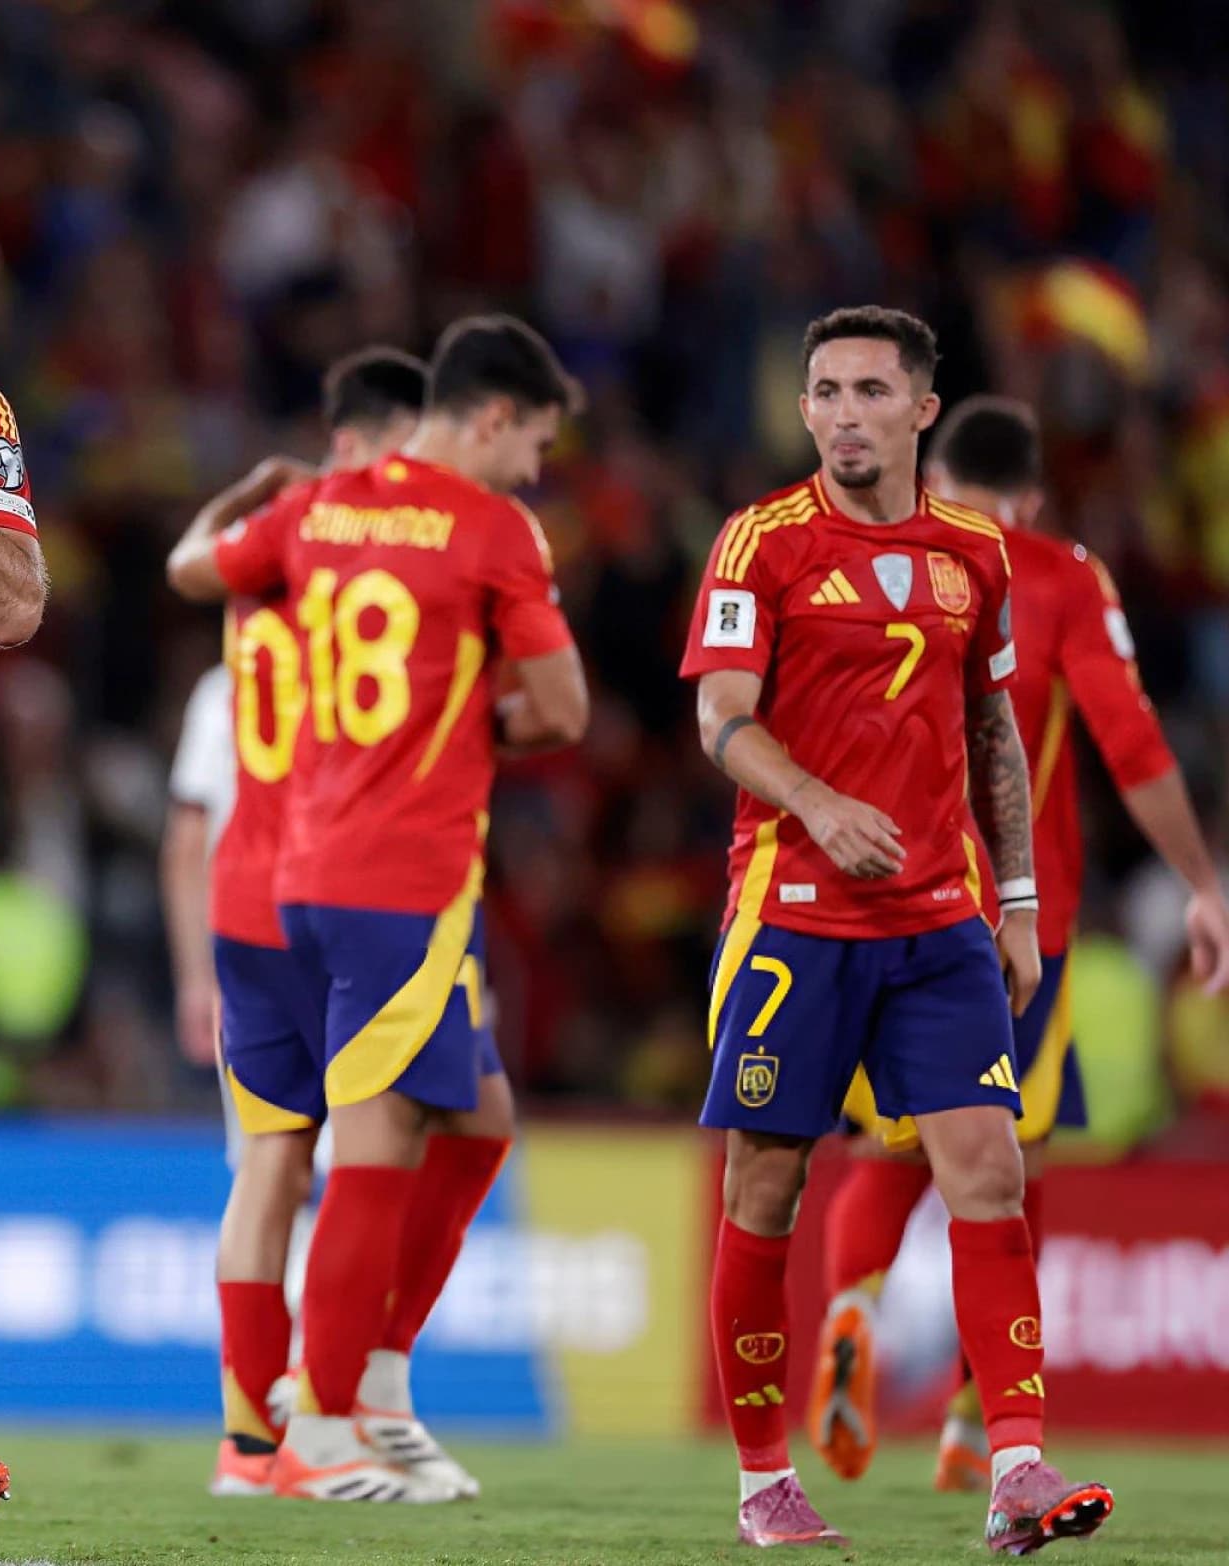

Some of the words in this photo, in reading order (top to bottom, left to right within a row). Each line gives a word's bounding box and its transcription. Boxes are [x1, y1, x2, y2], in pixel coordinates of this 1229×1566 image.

[296, 567, 420, 747] 18
[884, 623, 926, 701] 7
[746, 954, 793, 1037] 7
